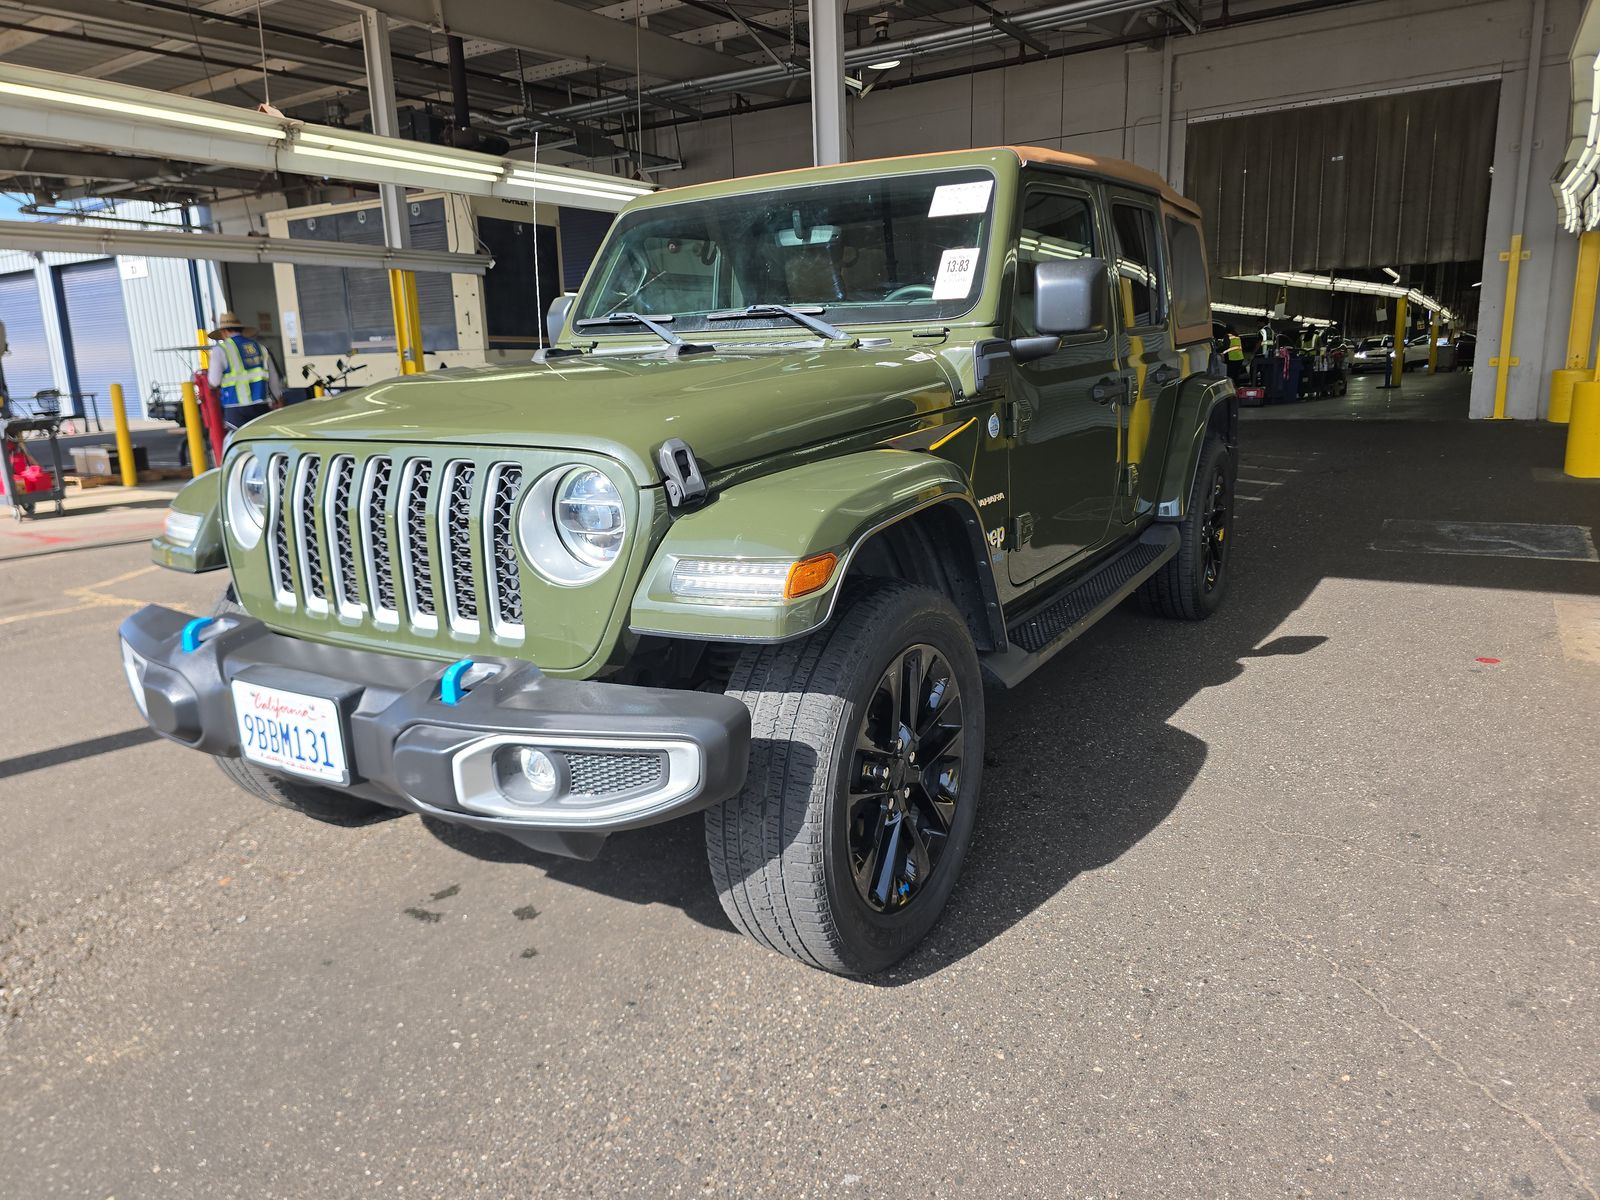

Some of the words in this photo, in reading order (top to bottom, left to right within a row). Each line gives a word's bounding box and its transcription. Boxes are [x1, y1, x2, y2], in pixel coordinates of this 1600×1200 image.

[946, 259, 970, 273] 13:83
[254, 692, 313, 719] California
[244, 713, 335, 768] 9BBM131
